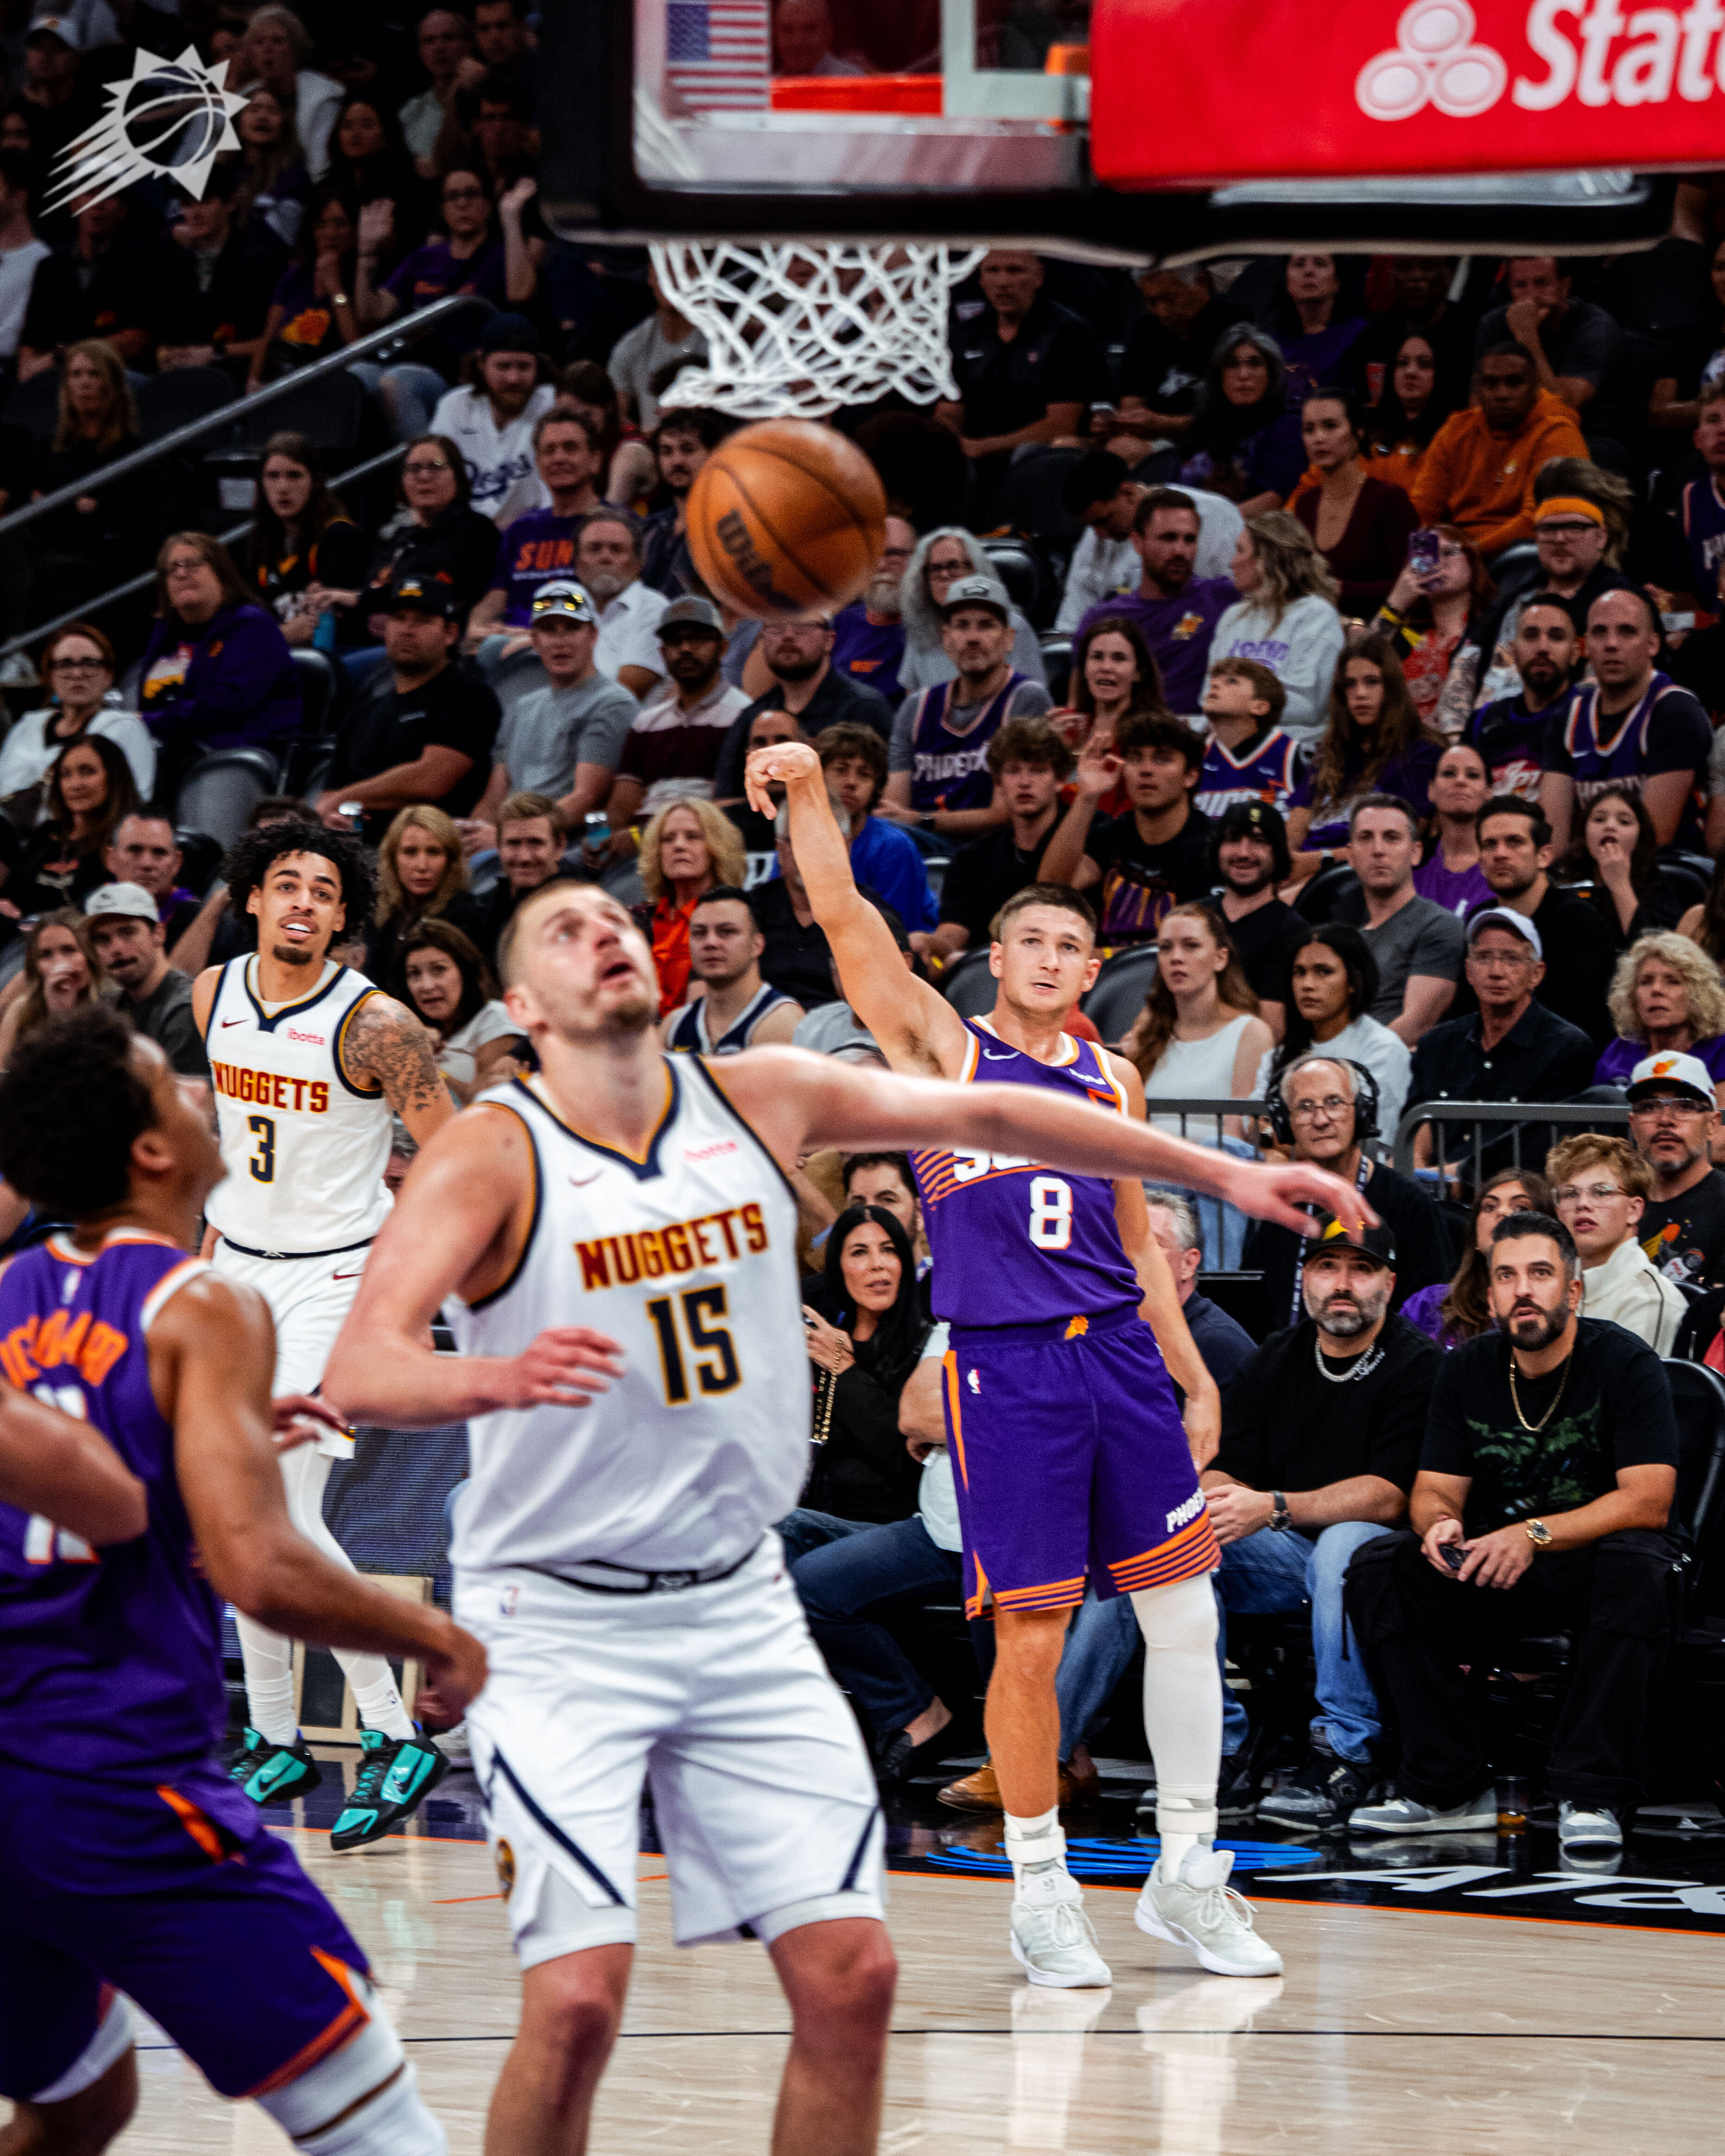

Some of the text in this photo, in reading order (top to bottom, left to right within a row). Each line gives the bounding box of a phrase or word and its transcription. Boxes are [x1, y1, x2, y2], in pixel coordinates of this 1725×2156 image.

[1511, 0, 1725, 111] Stat
[287, 1027, 325, 1046] ibotta
[209, 1059, 328, 1113] NUGGETS
[247, 1114, 276, 1184] 3
[573, 1200, 769, 1294] NUGGETS
[1029, 1176, 1073, 1250] 8
[645, 1281, 743, 1407] 15
